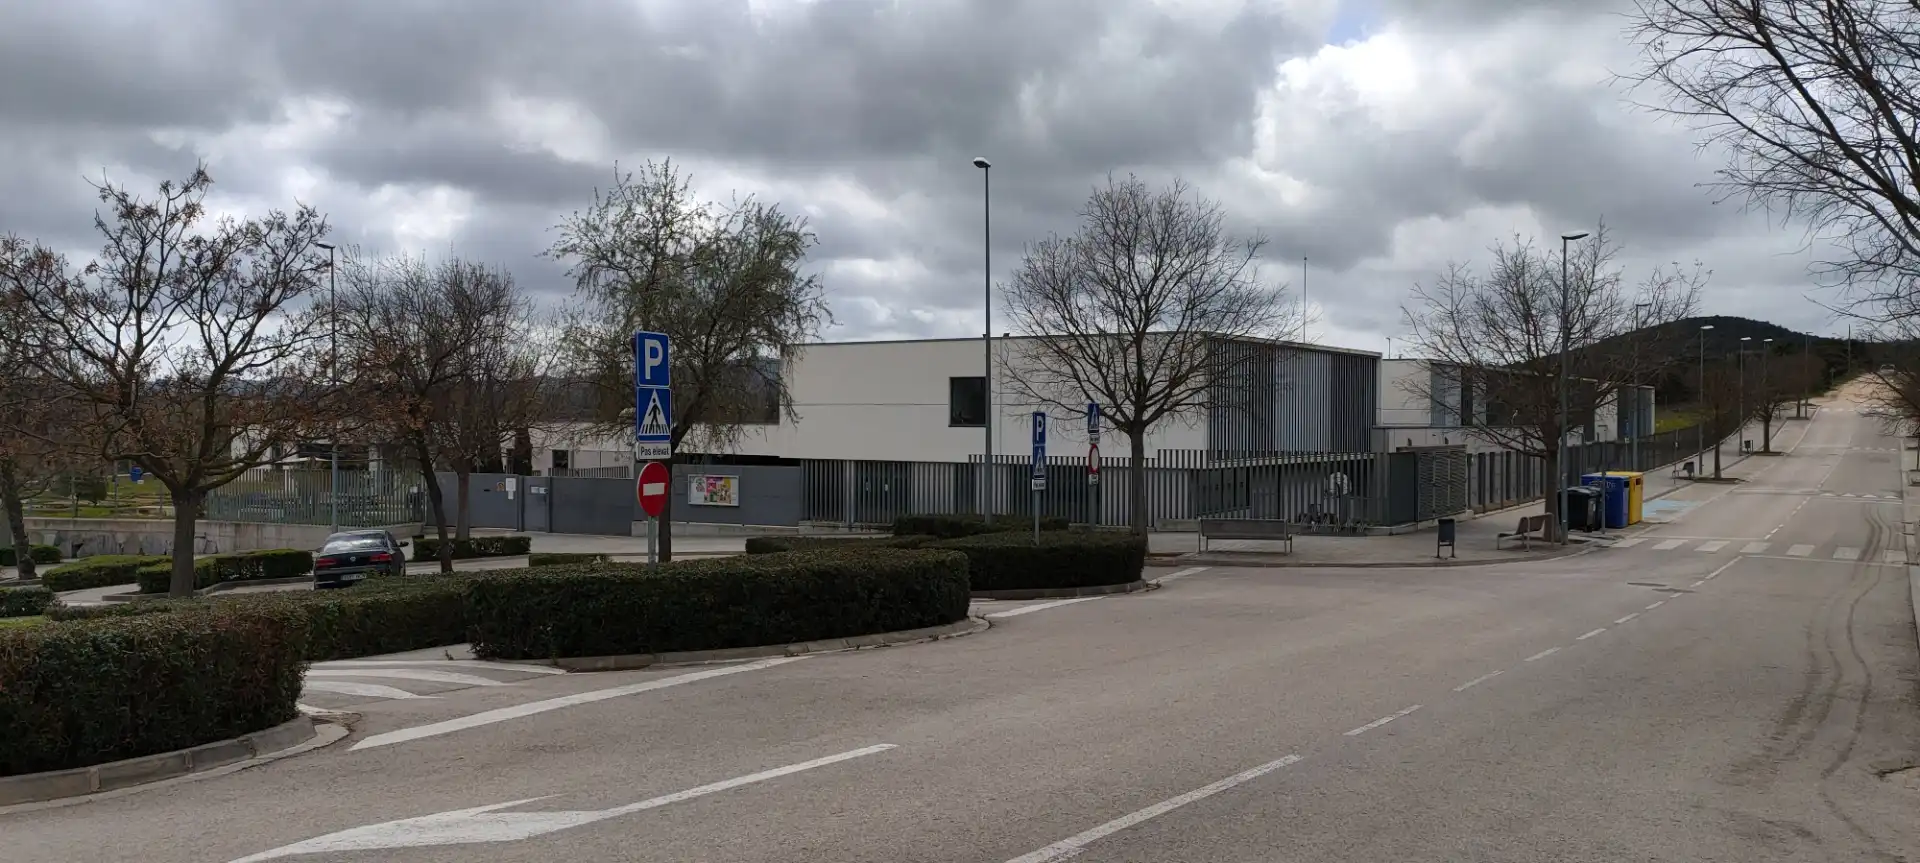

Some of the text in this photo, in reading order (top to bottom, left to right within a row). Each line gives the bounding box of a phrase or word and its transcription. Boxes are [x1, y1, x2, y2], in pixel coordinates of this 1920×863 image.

[644, 338, 663, 380] P
[1036, 415, 1044, 441] P
[640, 446, 670, 456] Pas elevat
